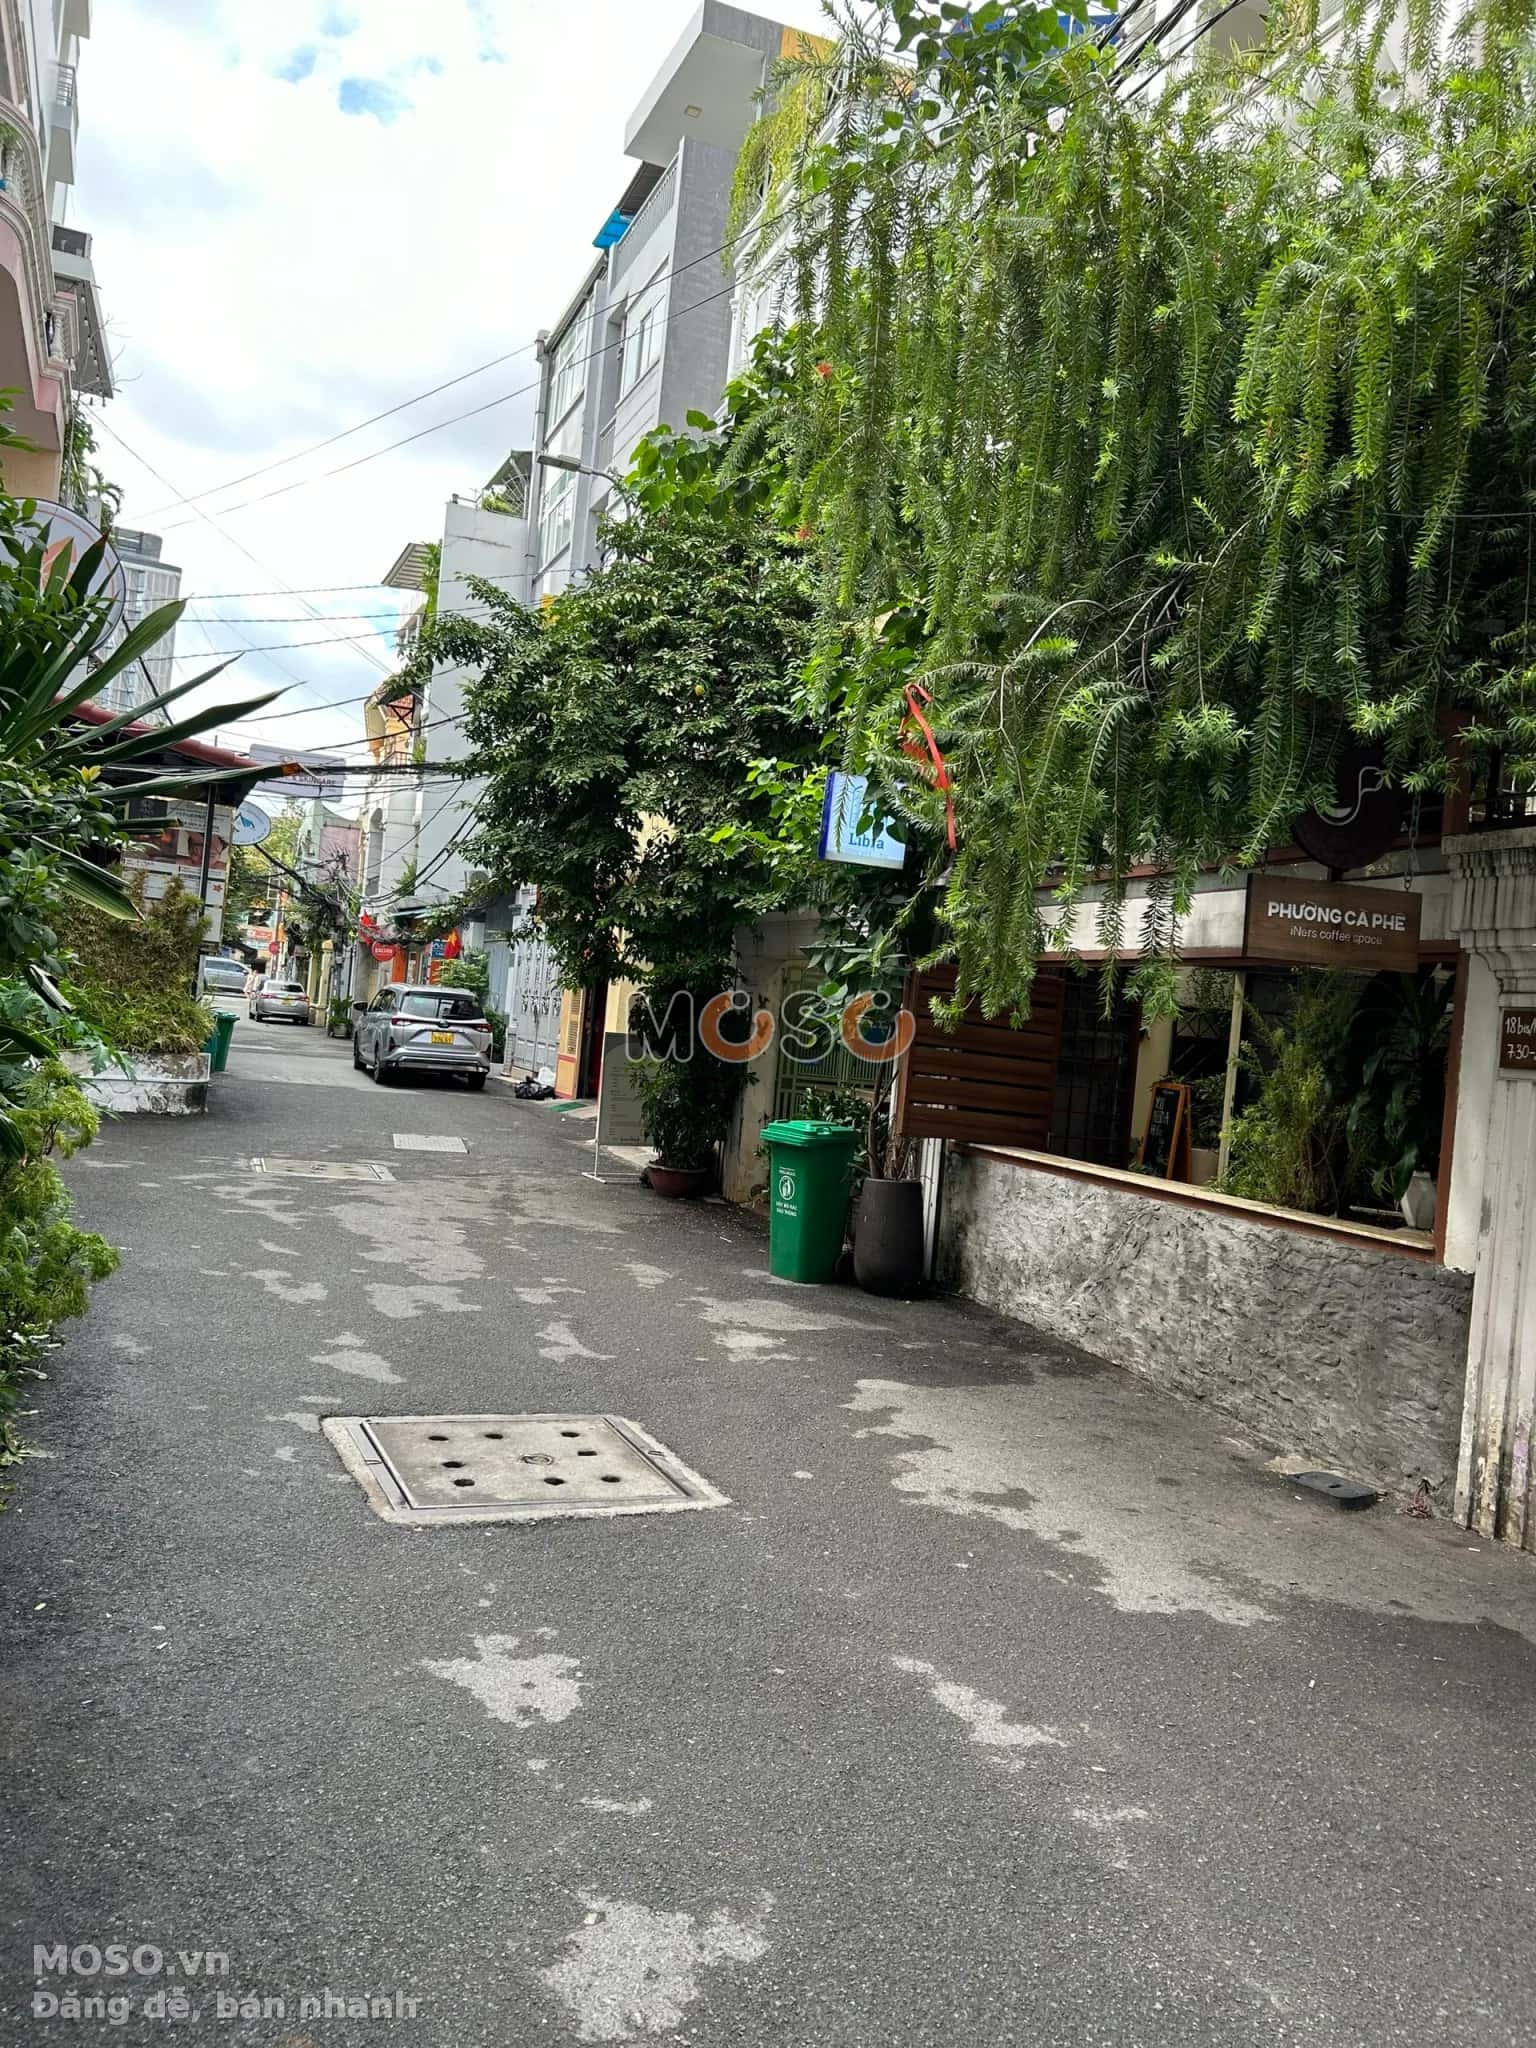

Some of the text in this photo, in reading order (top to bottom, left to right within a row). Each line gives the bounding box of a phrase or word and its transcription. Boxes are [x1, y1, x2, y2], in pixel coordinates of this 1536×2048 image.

[1267, 899, 1407, 932] PHƯỜNG CÀ PHÊ
[1319, 930, 1351, 942] coffee
